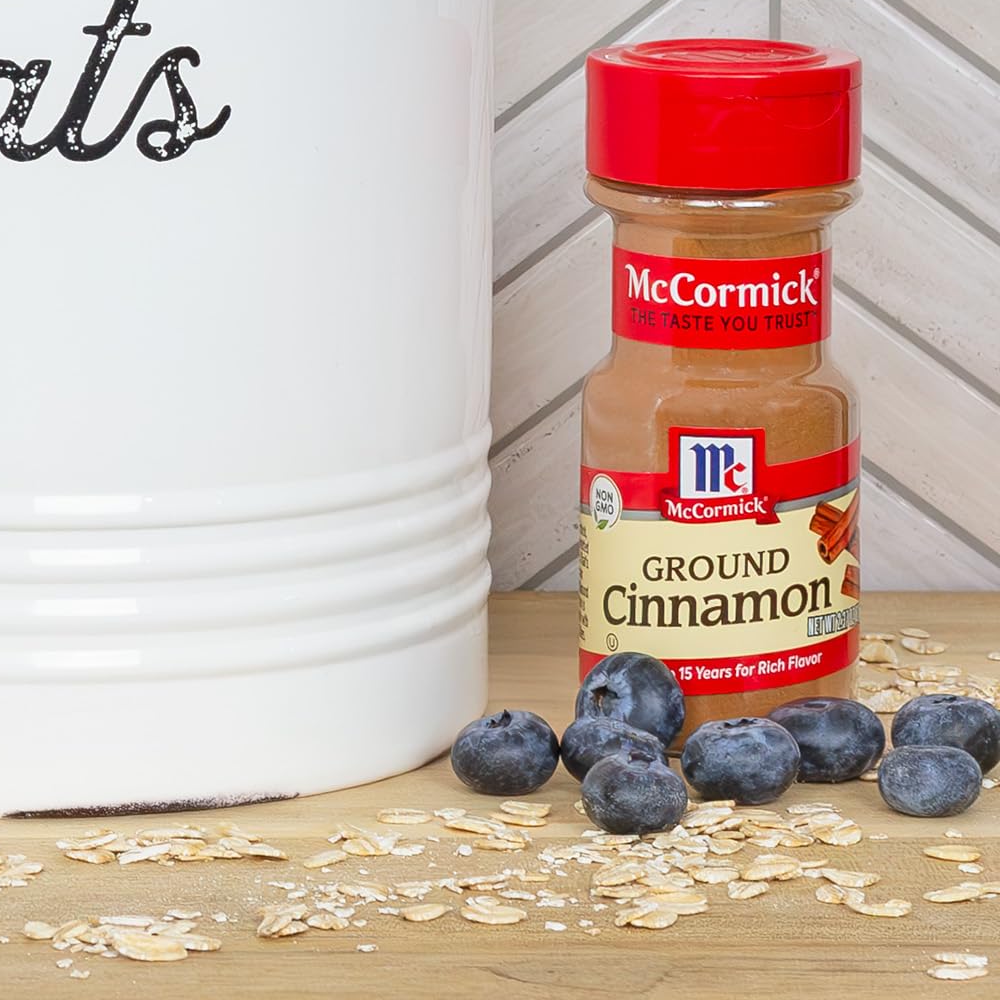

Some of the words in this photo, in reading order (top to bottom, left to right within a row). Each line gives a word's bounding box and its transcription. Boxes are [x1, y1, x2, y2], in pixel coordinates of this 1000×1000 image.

[631, 308, 656, 327] THE
[661, 312, 714, 332] TASTE
[720, 316, 758, 332] YOU
[596, 488, 614, 503] NON
[596, 501, 615, 515] GMO
[642, 548, 790, 582] GROUND
[603, 576, 832, 627] Cinnamon
[678, 666, 693, 681] 15
[695, 665, 732, 680] Years
[735, 663, 755, 677] for
[757, 657, 786, 676] Rich
[788, 652, 823, 671] Flavor
